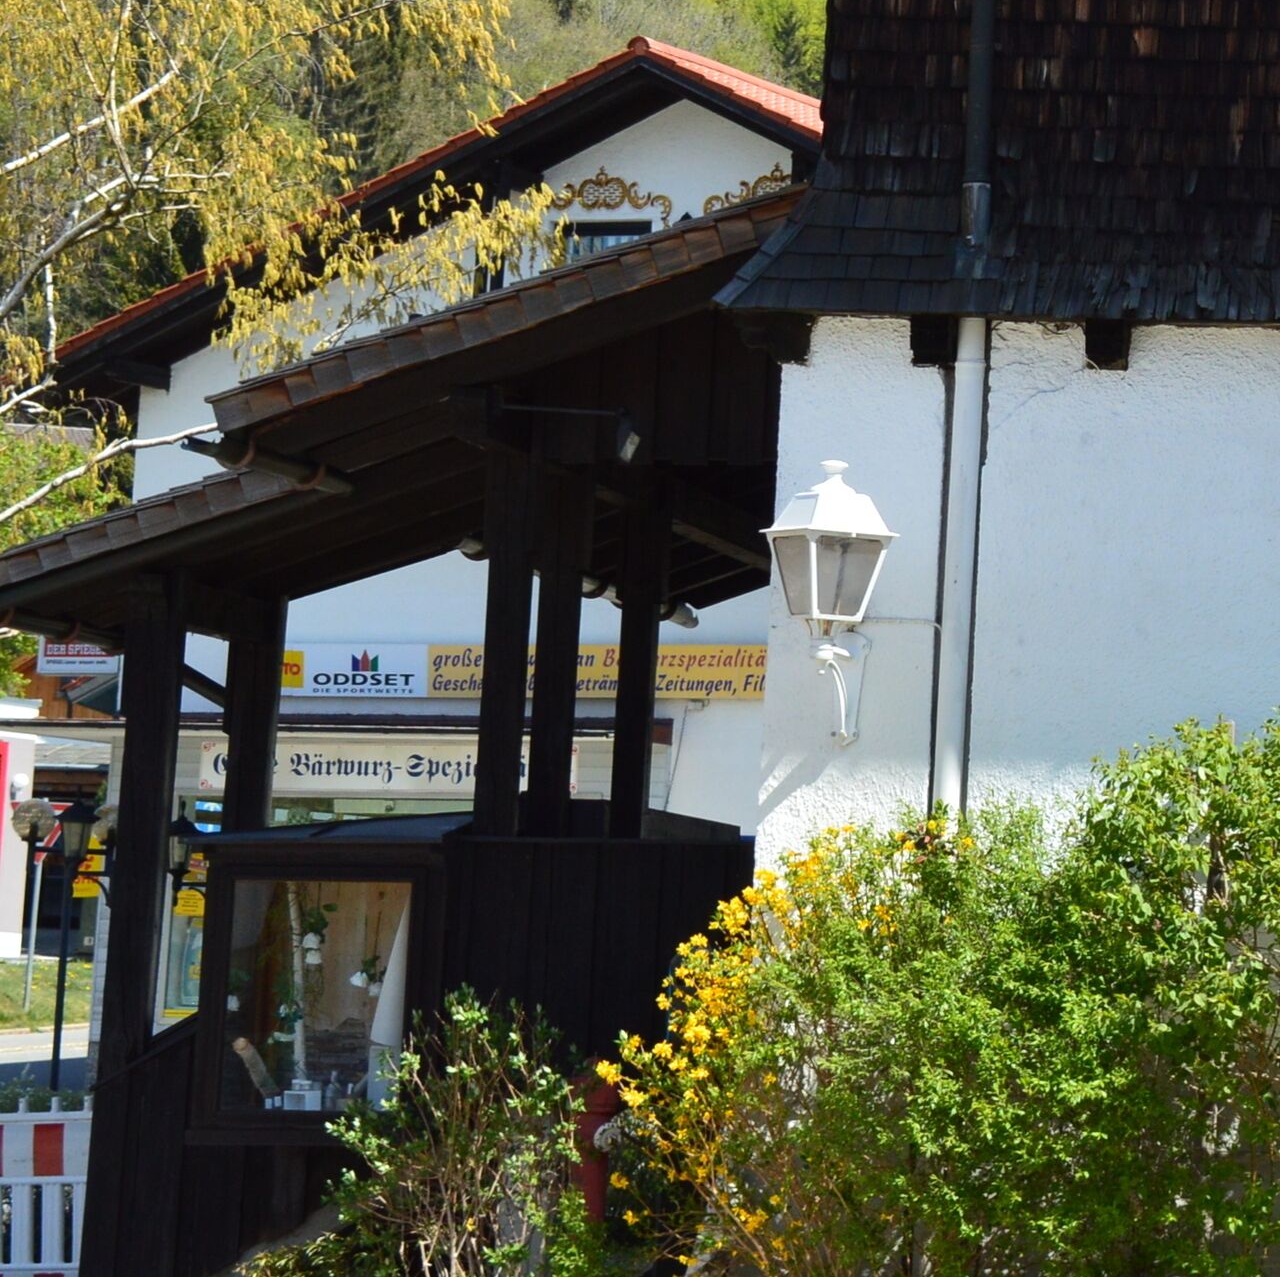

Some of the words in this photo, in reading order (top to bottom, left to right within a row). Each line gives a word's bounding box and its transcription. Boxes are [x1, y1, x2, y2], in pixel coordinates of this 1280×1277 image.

[433, 648, 482, 672] große
[313, 673, 415, 686] ODDSET
[655, 674, 737, 696] Zeitungen,
[742, 675, 766, 692] Fil
